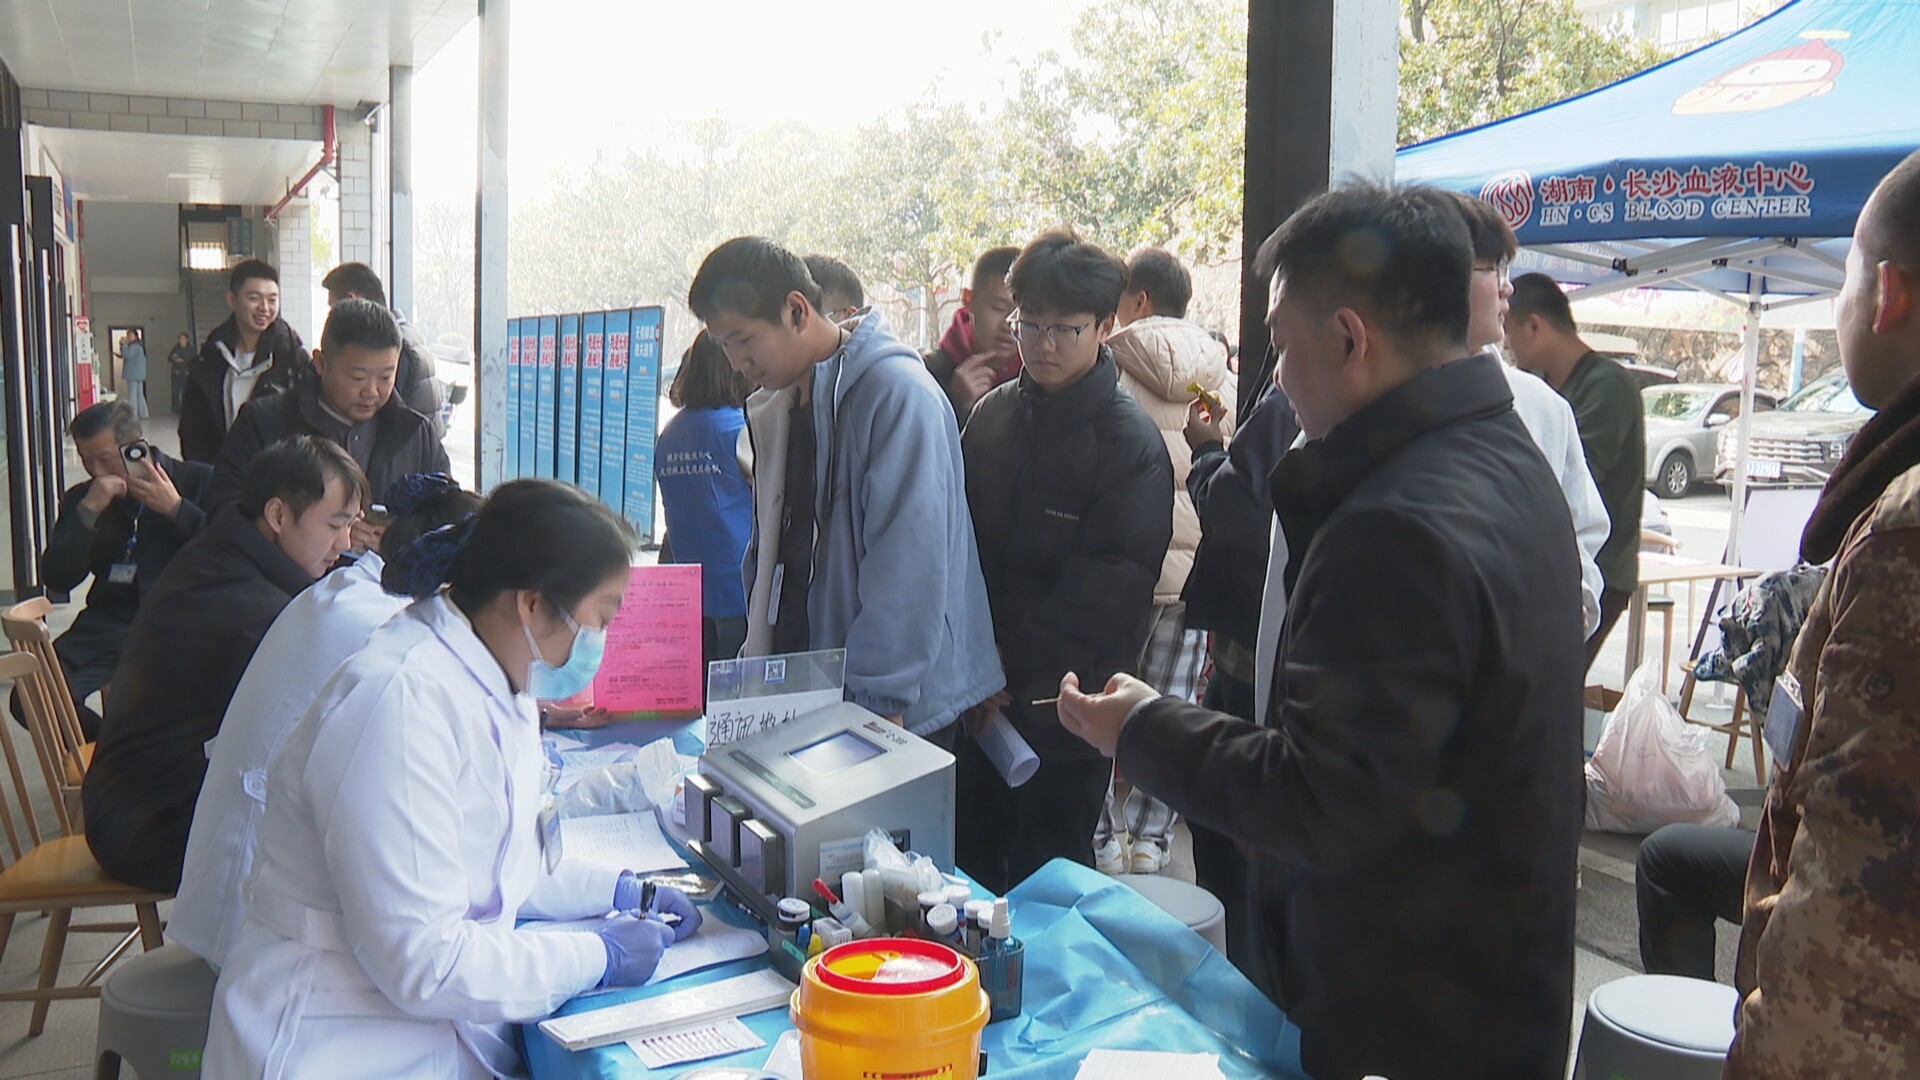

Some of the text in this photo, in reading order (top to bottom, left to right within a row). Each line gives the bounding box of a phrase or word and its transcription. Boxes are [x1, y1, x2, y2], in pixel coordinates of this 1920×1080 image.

[1541, 163, 1811, 204] 湖南 长沙血液中心
[1627, 200, 1703, 220] BLOOD
[1712, 196, 1811, 218] CENTER
